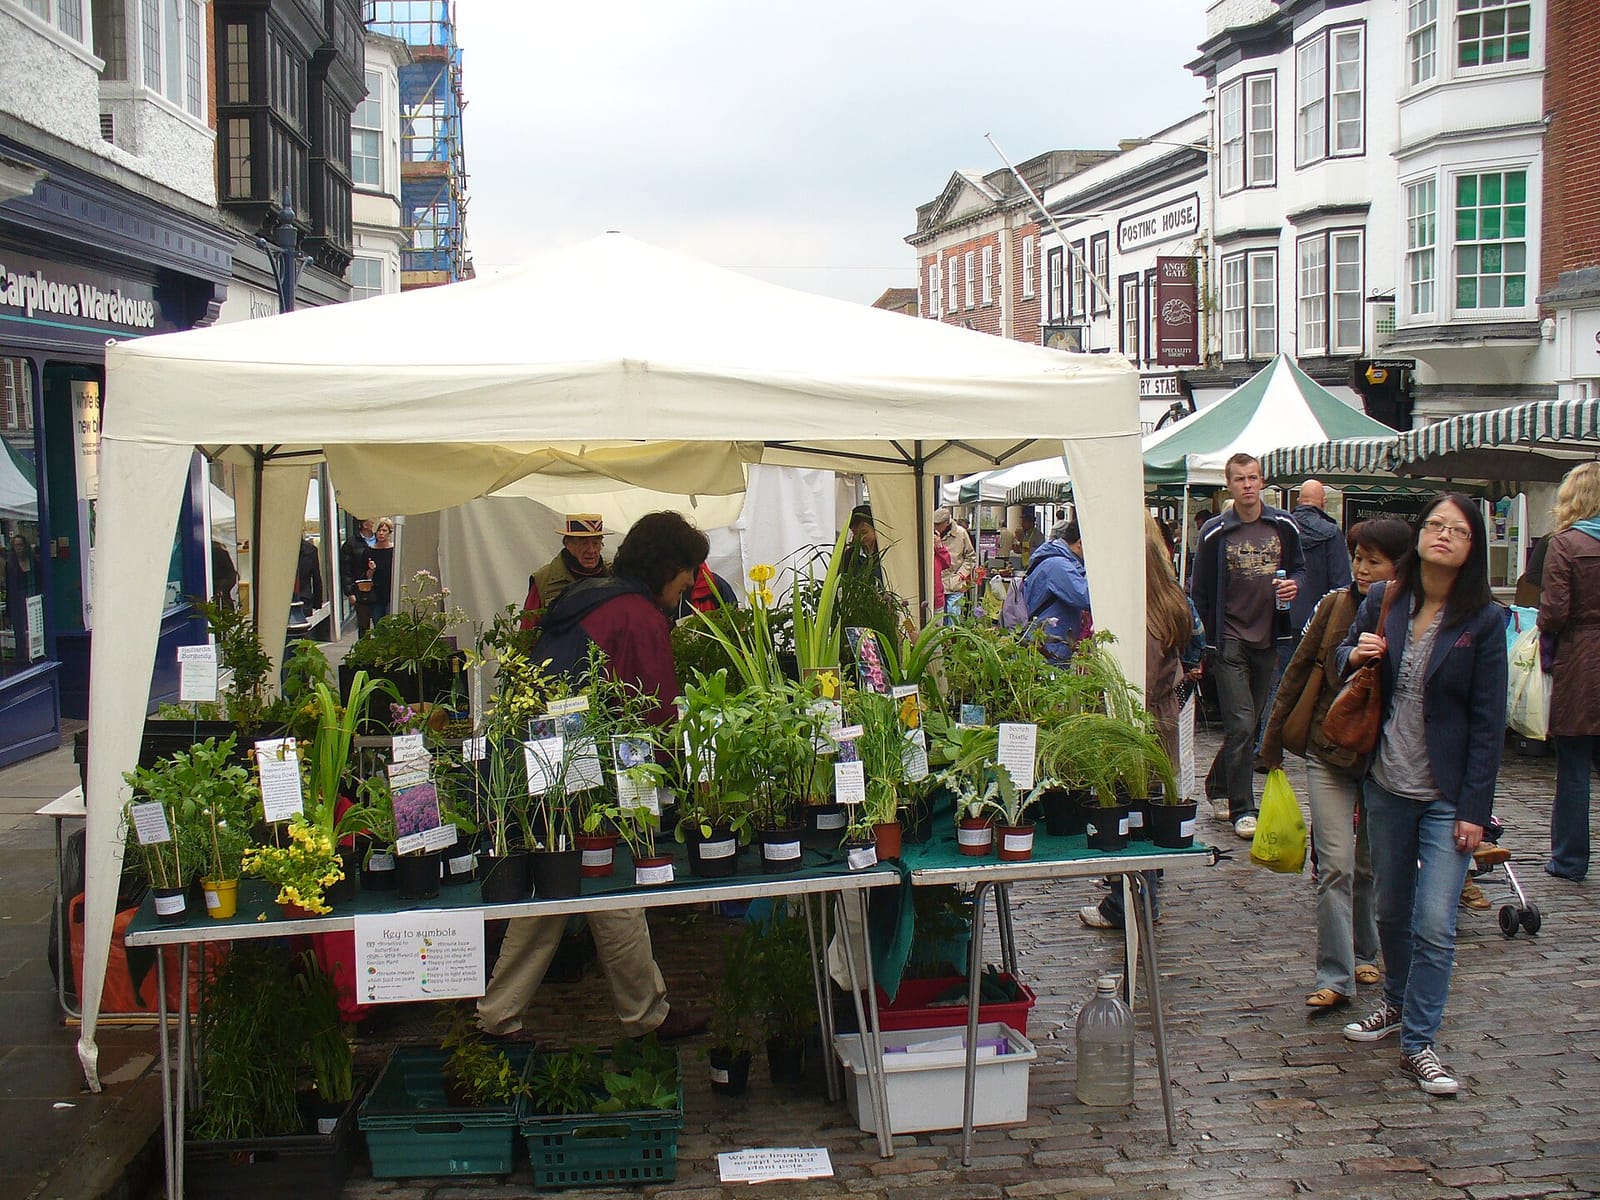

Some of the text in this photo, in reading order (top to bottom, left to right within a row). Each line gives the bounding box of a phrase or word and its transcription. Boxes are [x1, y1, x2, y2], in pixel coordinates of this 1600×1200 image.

[1163, 206, 1196, 232] HOUSE.
[0, 263, 155, 328] Carphone Warehouse
[384, 928, 457, 940] Key to symbols
